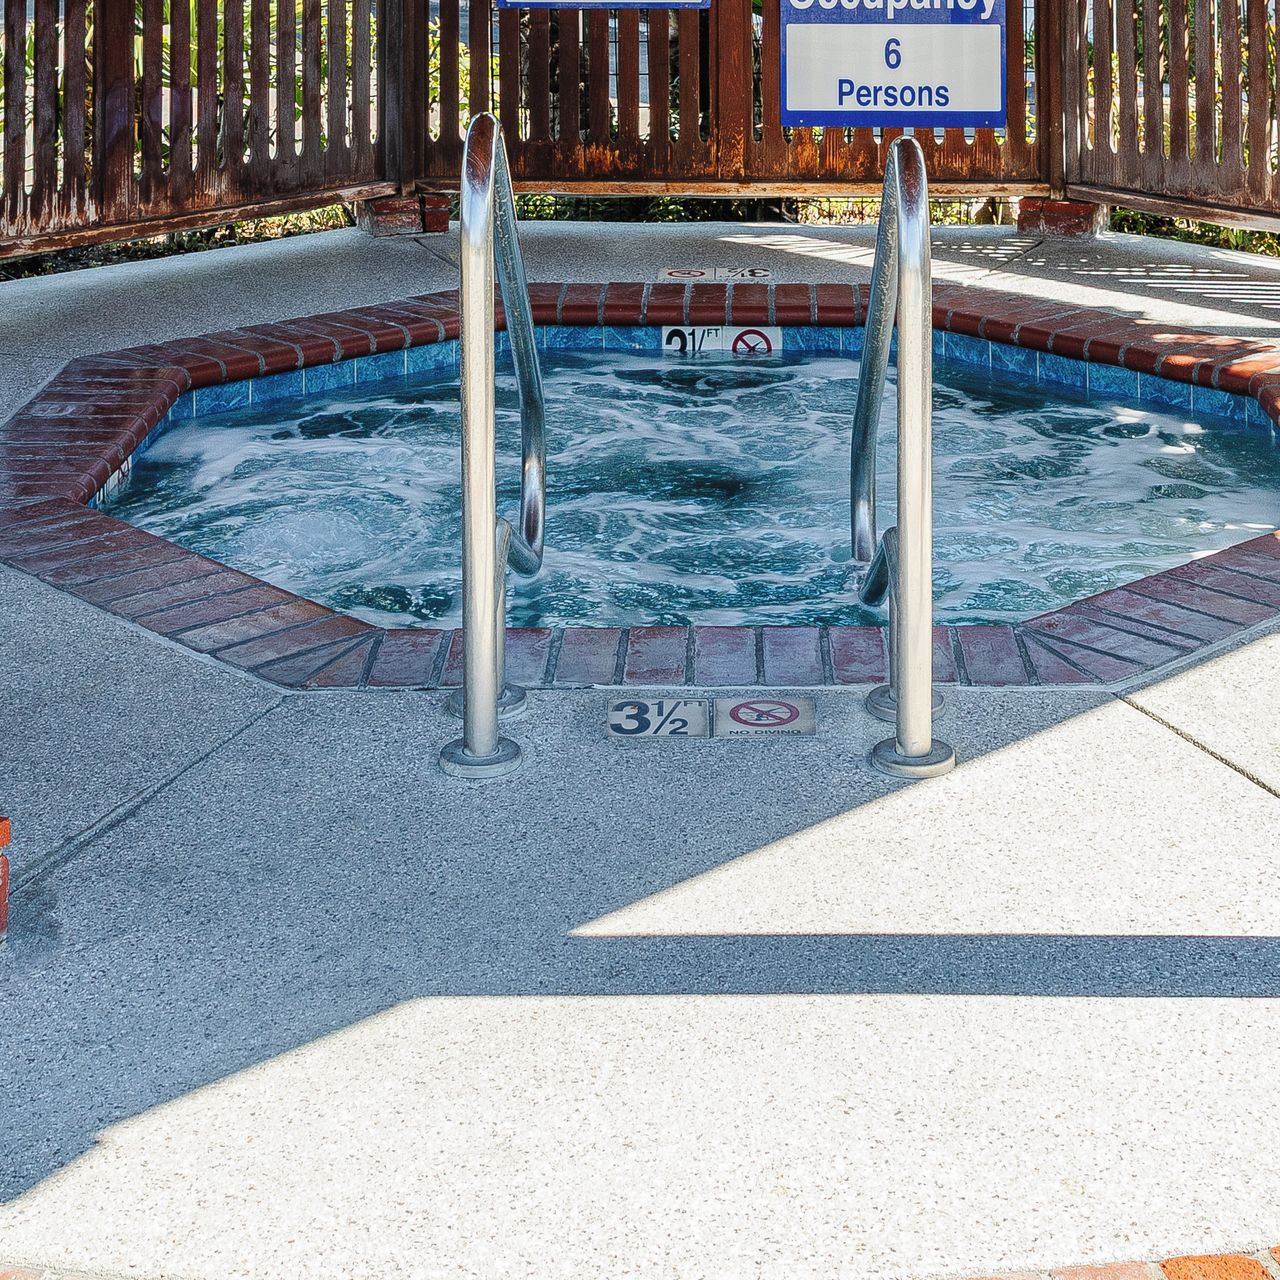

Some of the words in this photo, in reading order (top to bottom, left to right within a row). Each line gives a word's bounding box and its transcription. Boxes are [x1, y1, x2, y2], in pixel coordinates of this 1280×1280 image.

[883, 37, 902, 70] 6
[837, 78, 950, 107] Persons
[707, 328, 720, 338] FT
